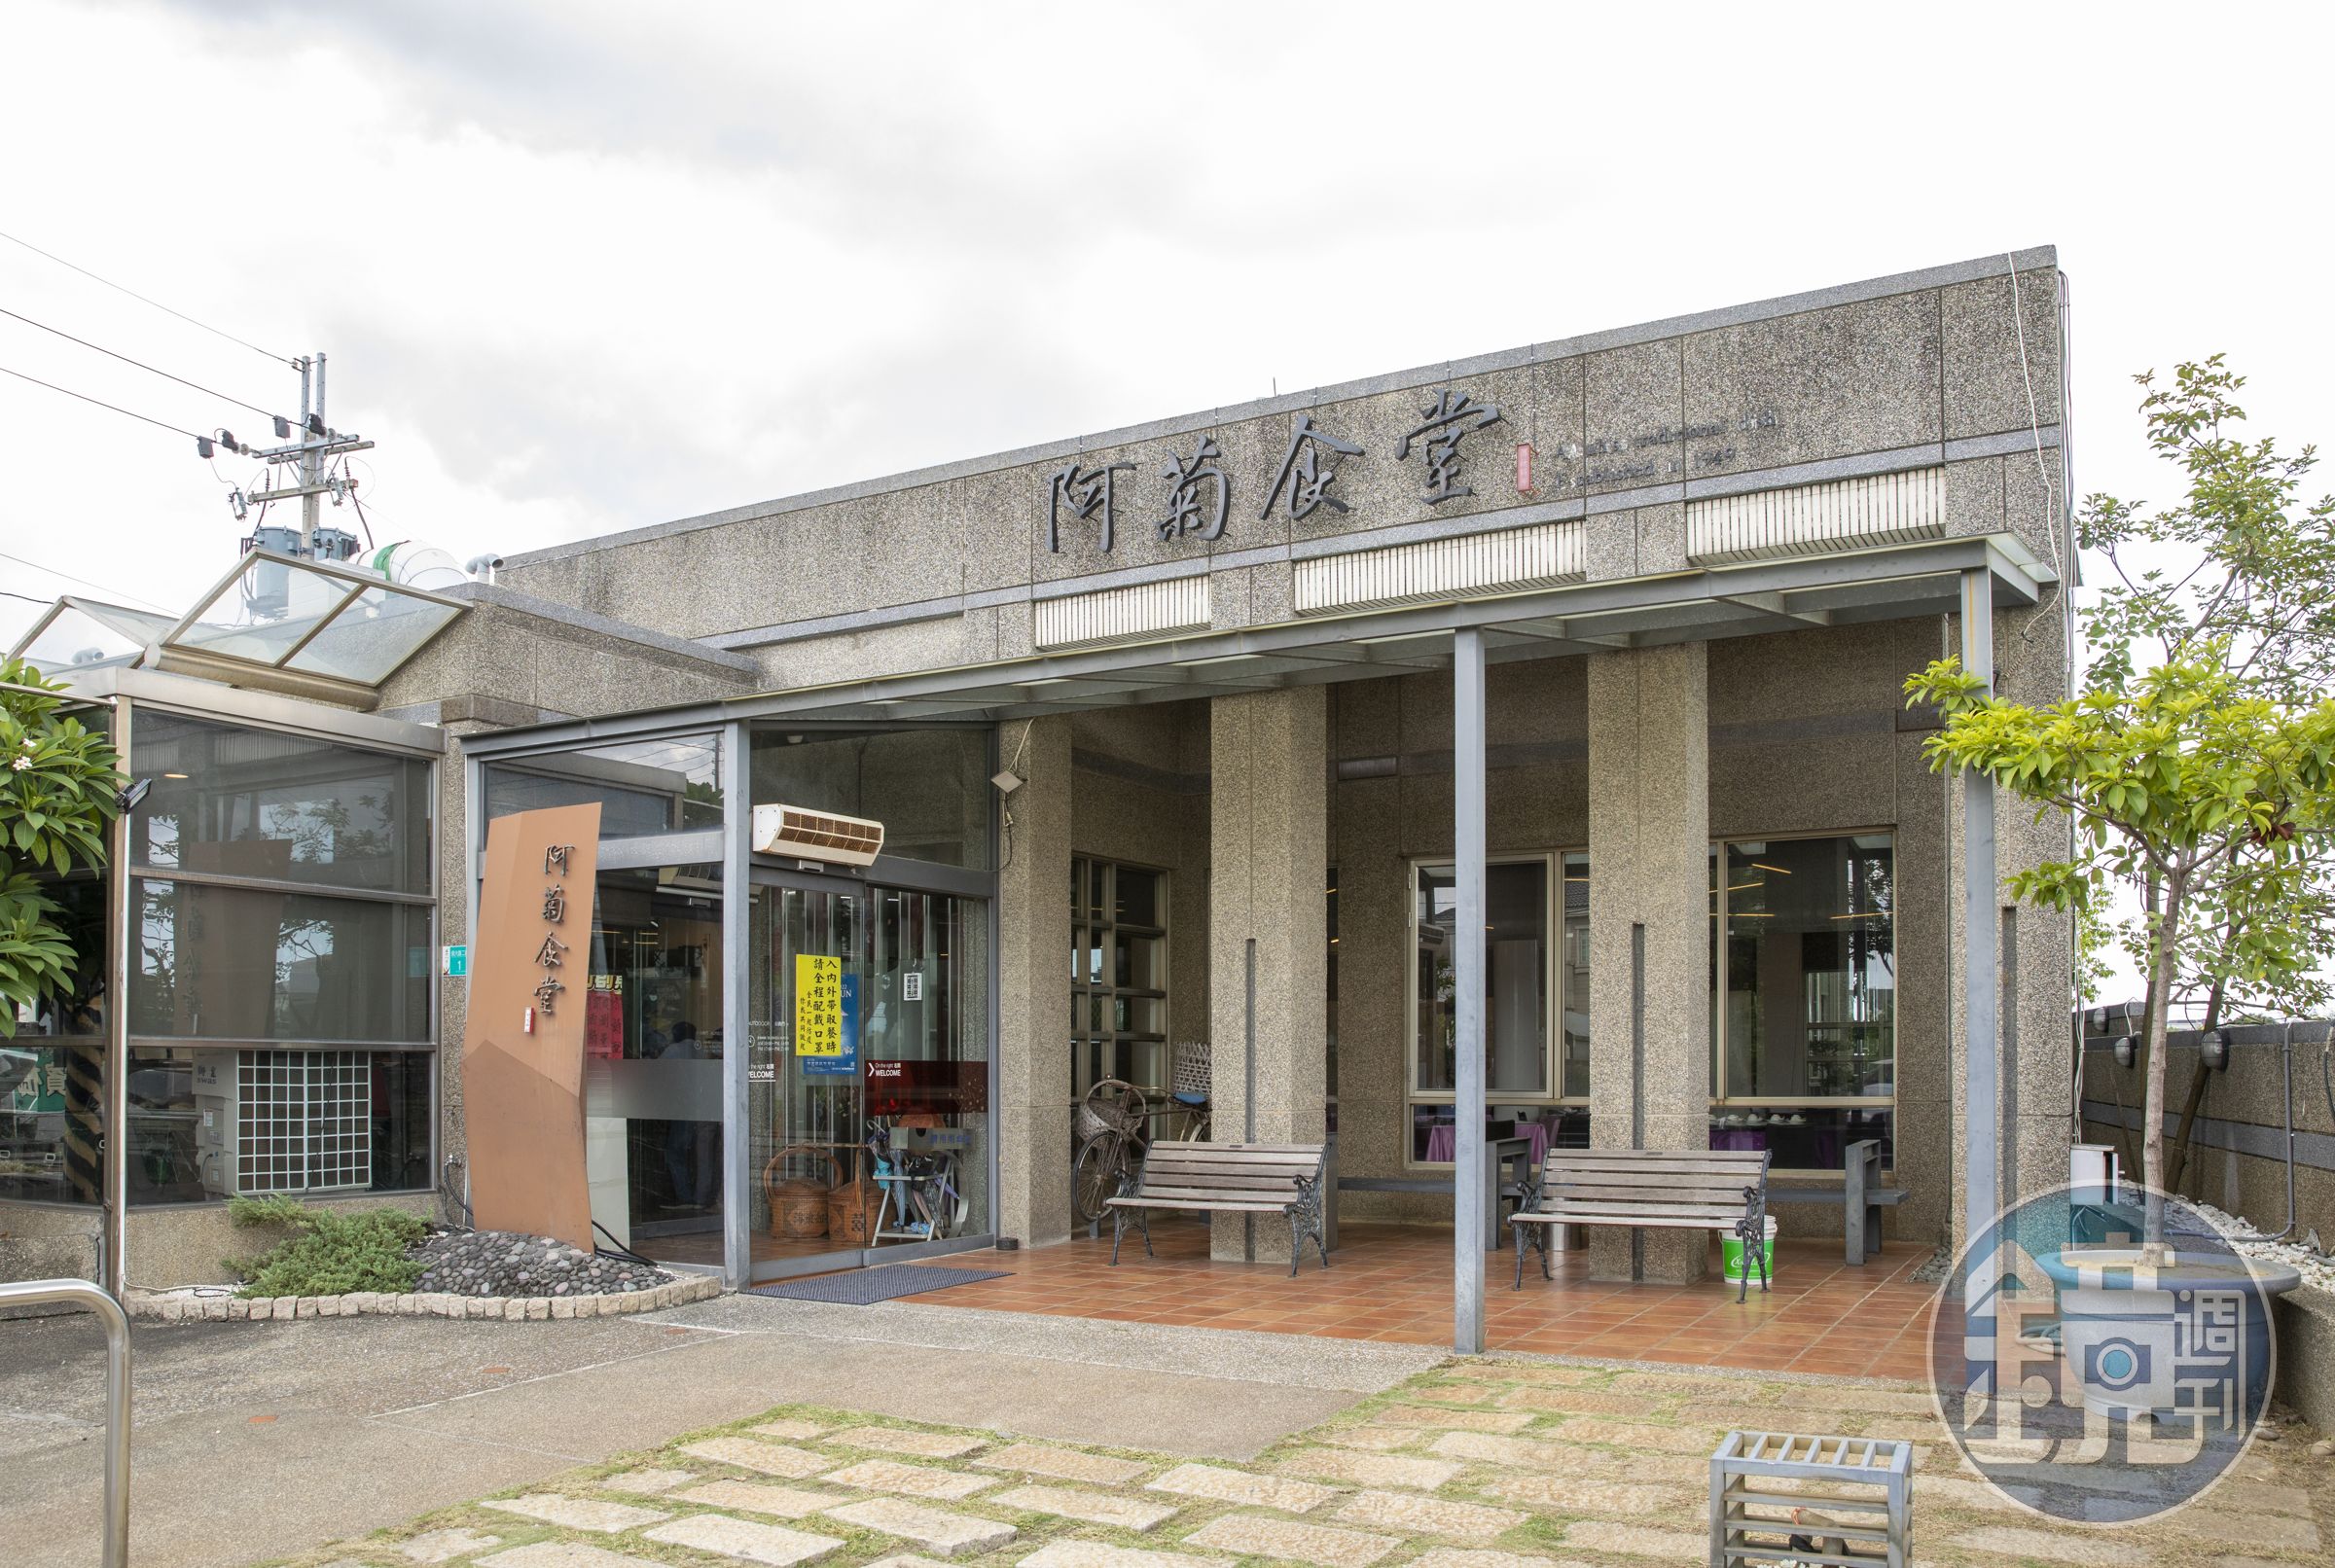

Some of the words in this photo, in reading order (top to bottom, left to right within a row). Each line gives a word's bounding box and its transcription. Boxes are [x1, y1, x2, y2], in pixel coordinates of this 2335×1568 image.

[1045, 388, 1503, 553] 阿菊食堂
[533, 843, 576, 1015] 阿菊食堂
[826, 959, 838, 1053] 入內外帶取餐時
